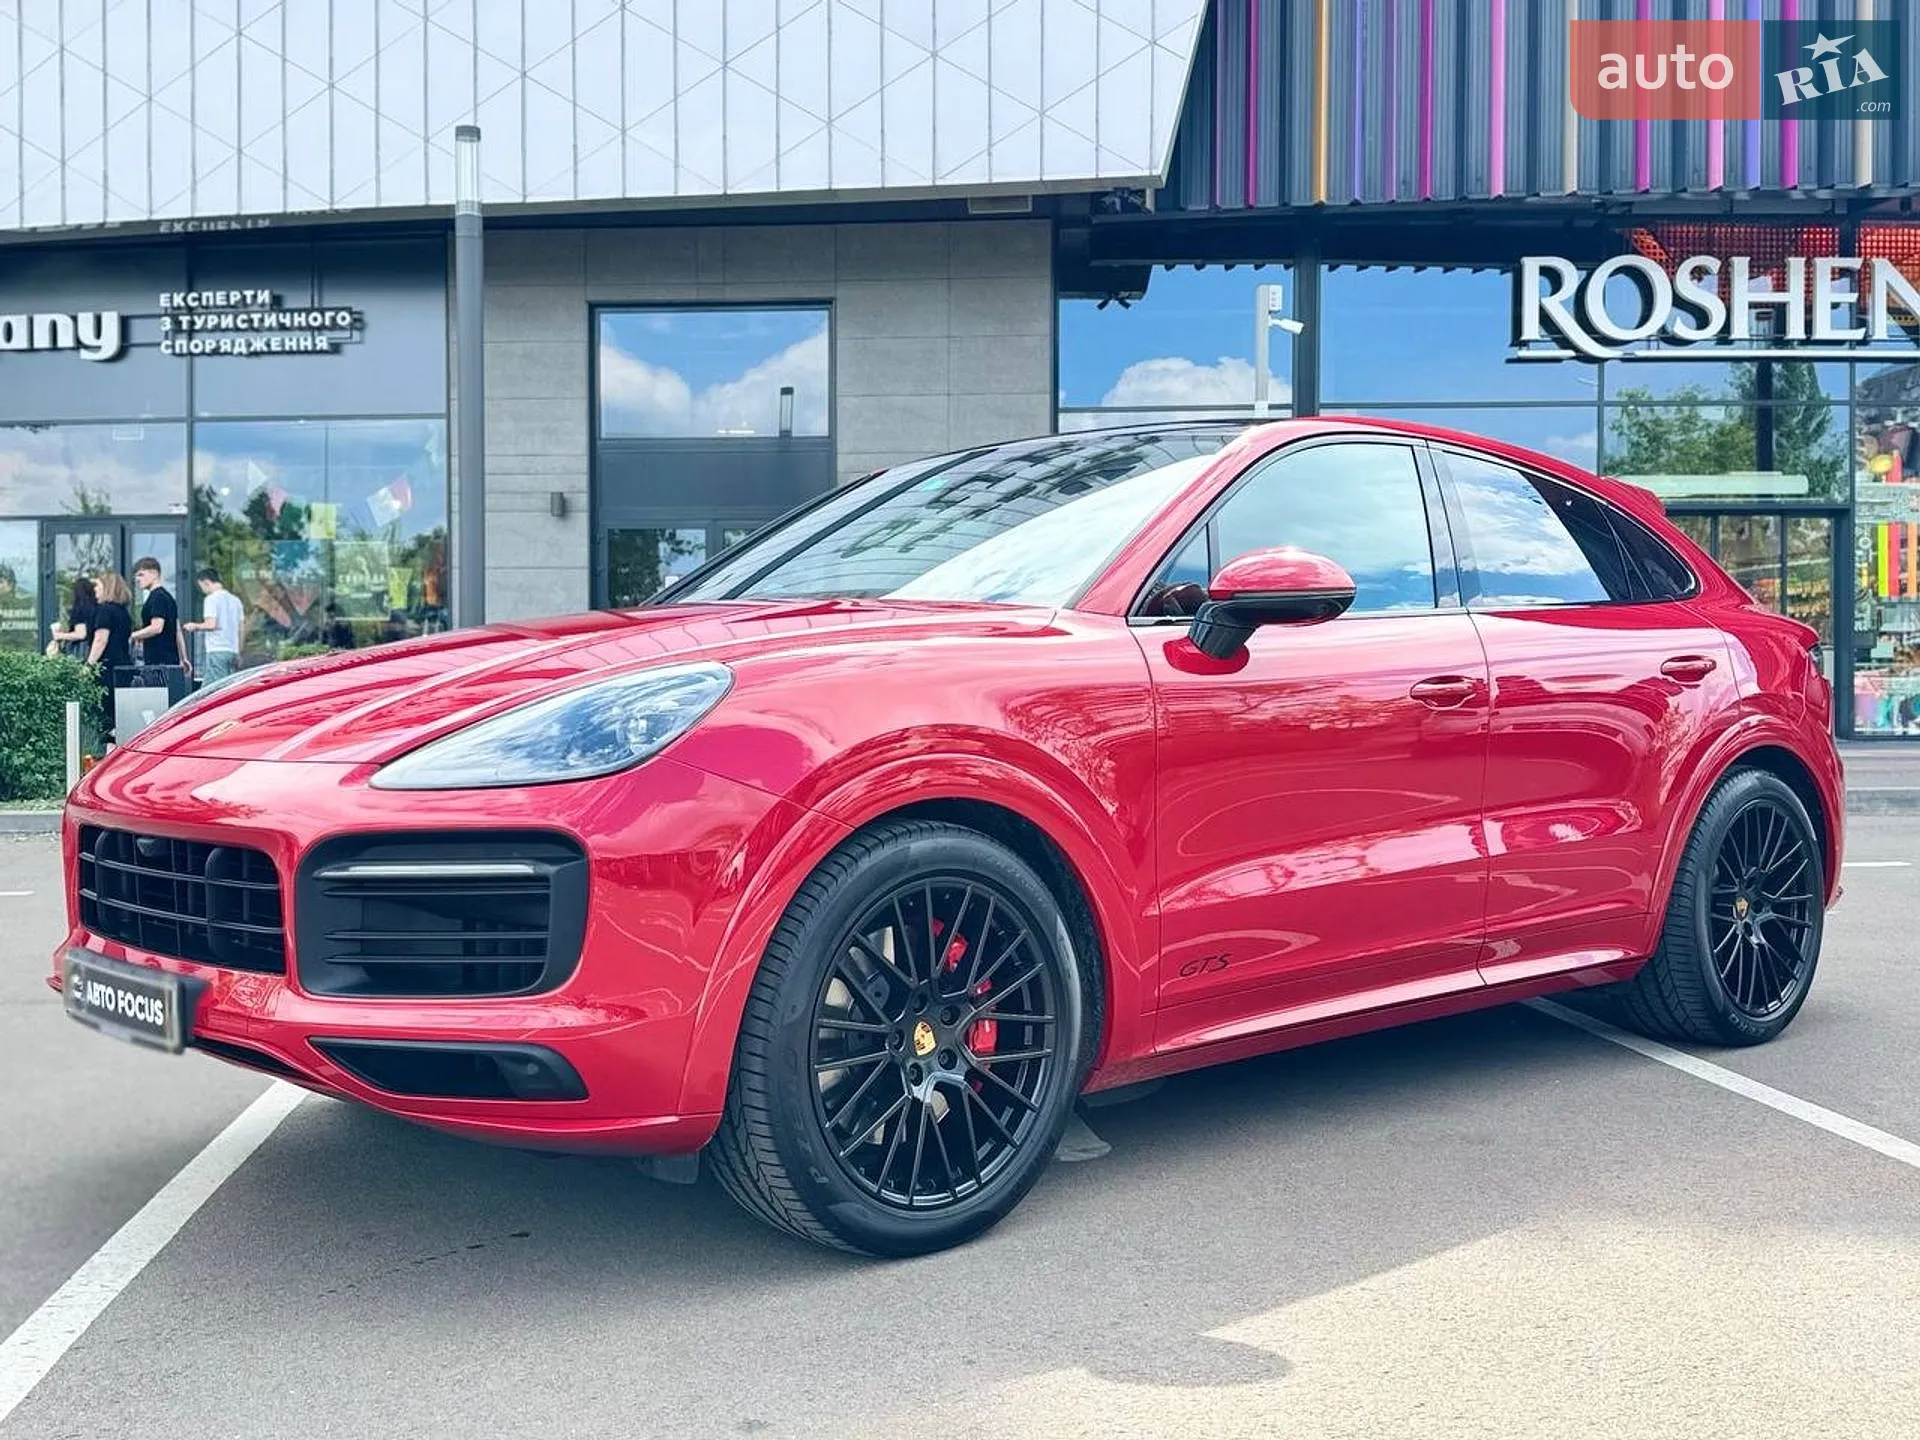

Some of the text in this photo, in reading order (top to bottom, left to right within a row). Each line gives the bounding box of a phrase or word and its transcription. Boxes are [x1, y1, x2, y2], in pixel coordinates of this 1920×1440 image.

[159, 289, 270, 308] ЕКСПЕРТИ
[178, 311, 352, 330] ТУРИСТИЧНОГО
[160, 336, 329, 355] СПОРЯДЖЕННЯ
[1179, 953, 1234, 977] GTS
[117, 989, 164, 1026] FOCUS
